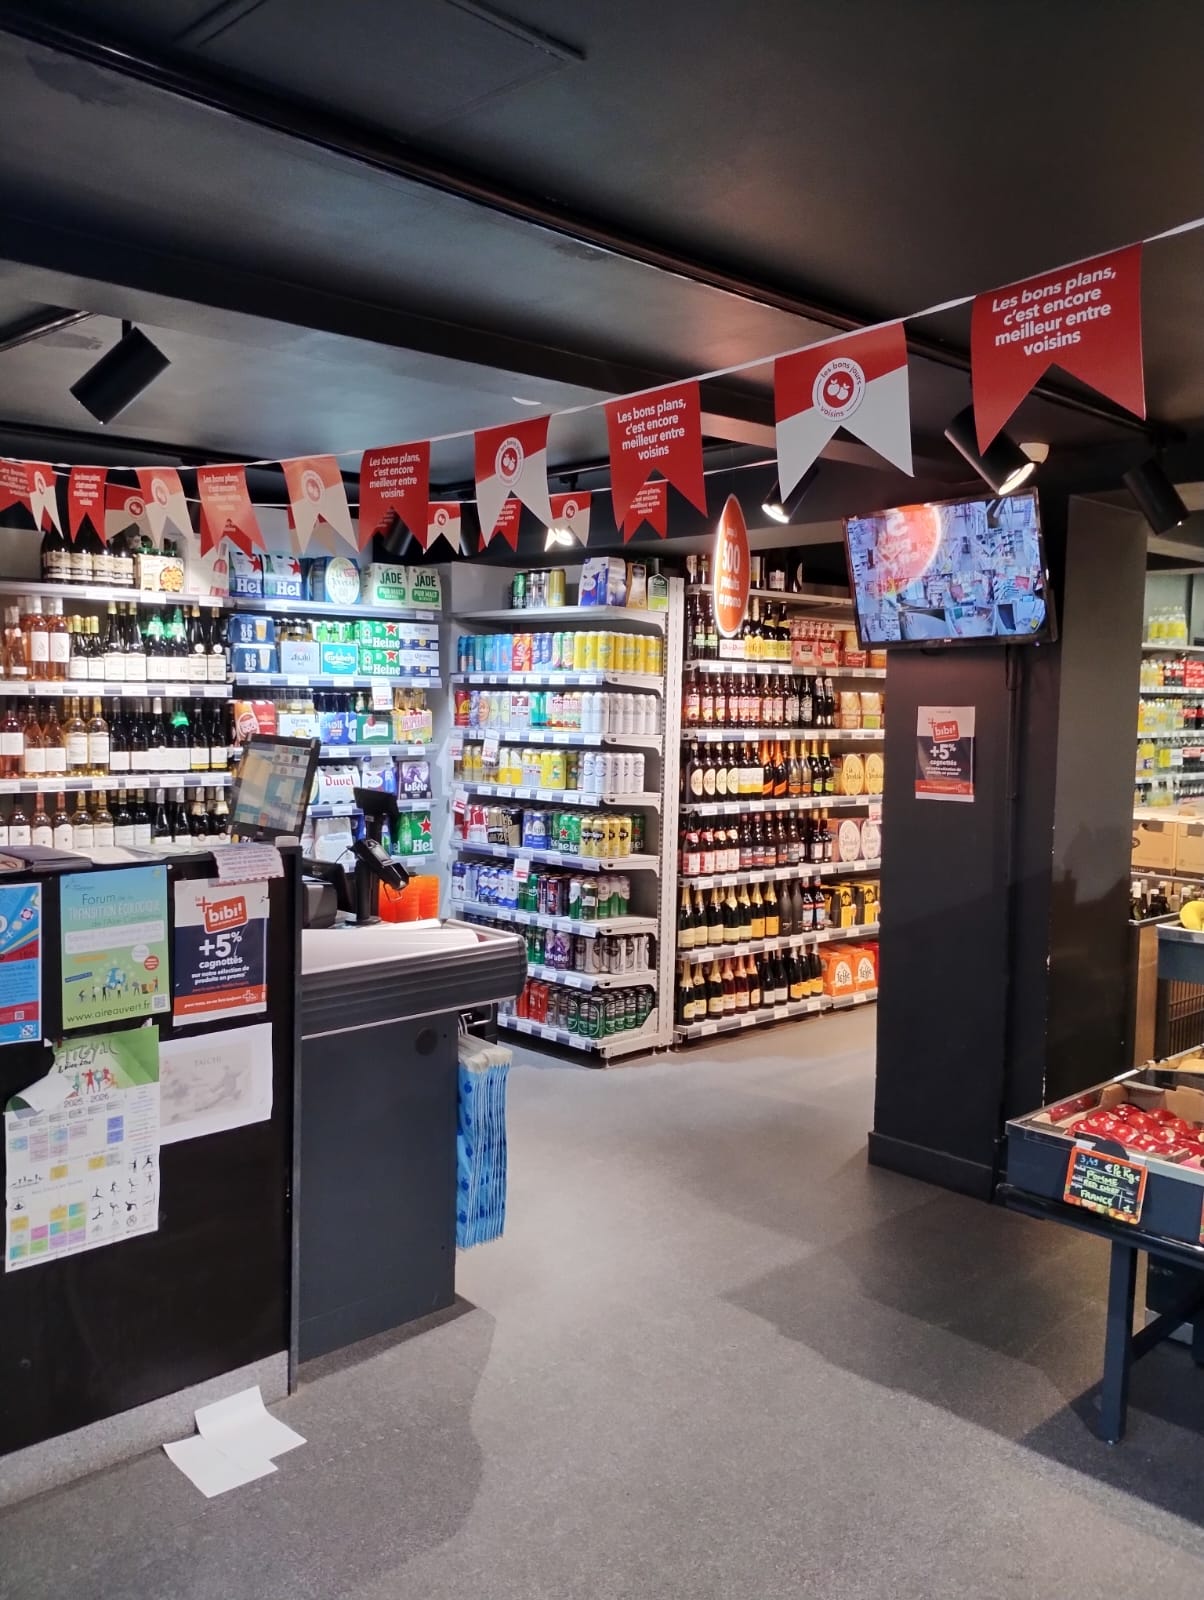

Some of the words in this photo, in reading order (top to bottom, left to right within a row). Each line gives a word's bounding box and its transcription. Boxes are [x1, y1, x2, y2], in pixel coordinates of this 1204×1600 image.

[992, 295, 1017, 312] Les
[1021, 281, 1062, 304] bons
[1066, 266, 1116, 294] plans,
[1004, 304, 1039, 326] c'est
[1042, 286, 1102, 314] encore
[995, 316, 1062, 346] meilleur
[1066, 303, 1112, 326] entre
[1024, 330, 1081, 356] voisins
[821, 367, 832, 378] les
[832, 362, 850, 370] bons
[850, 366, 862, 385] jours
[618, 411, 632, 424] Les
[634, 404, 655, 420] bons
[657, 398, 686, 414] plans,
[820, 406, 844, 418] voisins
[626, 422, 645, 436] c'est
[646, 414, 678, 430] encore
[622, 433, 658, 451] meilleur
[660, 426, 685, 441] entre
[370, 458, 380, 466] Les
[382, 456, 398, 465] bons
[400, 453, 420, 465] plans,
[638, 444, 669, 461] voisins
[374, 468, 388, 477] c'est
[390, 465, 413, 475] encore
[370, 478, 397, 488] meilleur
[398, 476, 417, 485] entre
[381, 488, 404, 498] voisins
[380, 572, 402, 584] JADE
[415, 576, 436, 587] JADE
[935, 725, 956, 736] bibi!
[930, 744, 956, 760] +5%
[325, 775, 354, 787] Duvel
[82, 894, 115, 905] Forum
[209, 902, 242, 923] bibi!
[199, 931, 242, 958] +5%
[66, 1000, 151, 1022] www.aireauvert.fr
[1086, 1170, 1118, 1186] POMME
[1080, 1189, 1113, 1206] FRANCE
